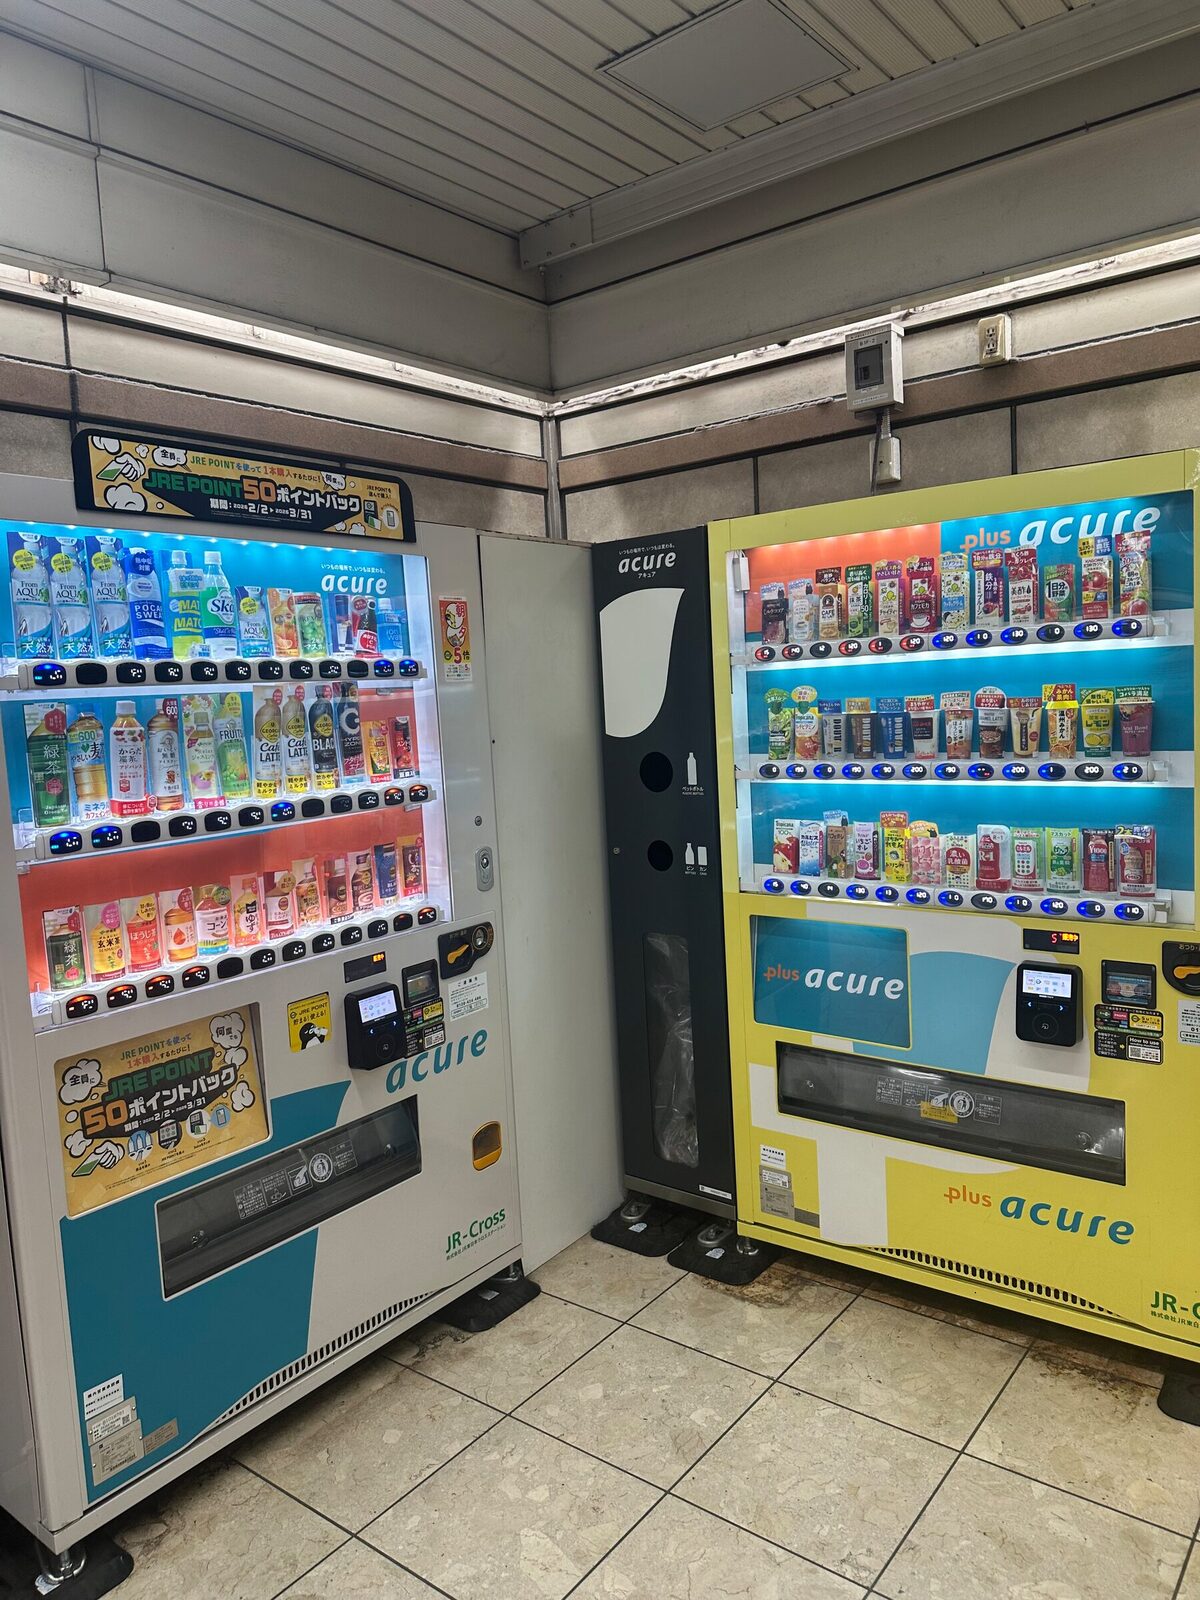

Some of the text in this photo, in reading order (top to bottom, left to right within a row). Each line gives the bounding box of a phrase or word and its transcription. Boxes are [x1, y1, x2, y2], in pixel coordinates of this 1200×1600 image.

[190, 455, 206, 466] JRE
[145, 472, 185, 493] JRE
[959, 506, 1161, 553] plus acure
[618, 552, 677, 574] acure
[637, 571, 656, 579] アキュア
[984, 572, 993, 591] 鉄分
[21, 580, 39, 588] From
[59, 582, 77, 590] From
[99, 580, 117, 588] From
[321, 573, 388, 595] acure
[849, 596, 862, 604] 抹茶
[1052, 589, 1066, 598] 野菜
[1058, 710, 1066, 740] 温州みかん
[1085, 719, 1111, 728] レモン
[78, 731, 96, 741] 600
[833, 718, 842, 753] DOUTOR
[862, 716, 871, 752] DOUTOR
[894, 716, 903, 752] DOUTOR
[118, 747, 142, 755] からだ
[43, 744, 60, 775] 緑茶
[800, 833, 820, 842] カルピス
[992, 833, 1005, 842] R-1
[1089, 844, 1108, 854] Y1000
[947, 857, 969, 866] 乳酸菌
[979, 850, 995, 862] R-1
[245, 913, 257, 933] ゆず
[129, 929, 158, 942] ほうじ茶
[97, 936, 121, 949] 玄米茶
[63, 940, 78, 966] 緑茶
[763, 963, 905, 1001] plus acure
[310, 1001, 328, 1014] POINT
[119, 1047, 137, 1061] JRE
[385, 1027, 489, 1095] acure
[106, 1052, 213, 1100] JRE POINT
[943, 1184, 1136, 1245] plus acure
[445, 1208, 506, 1254] JR-Cross
